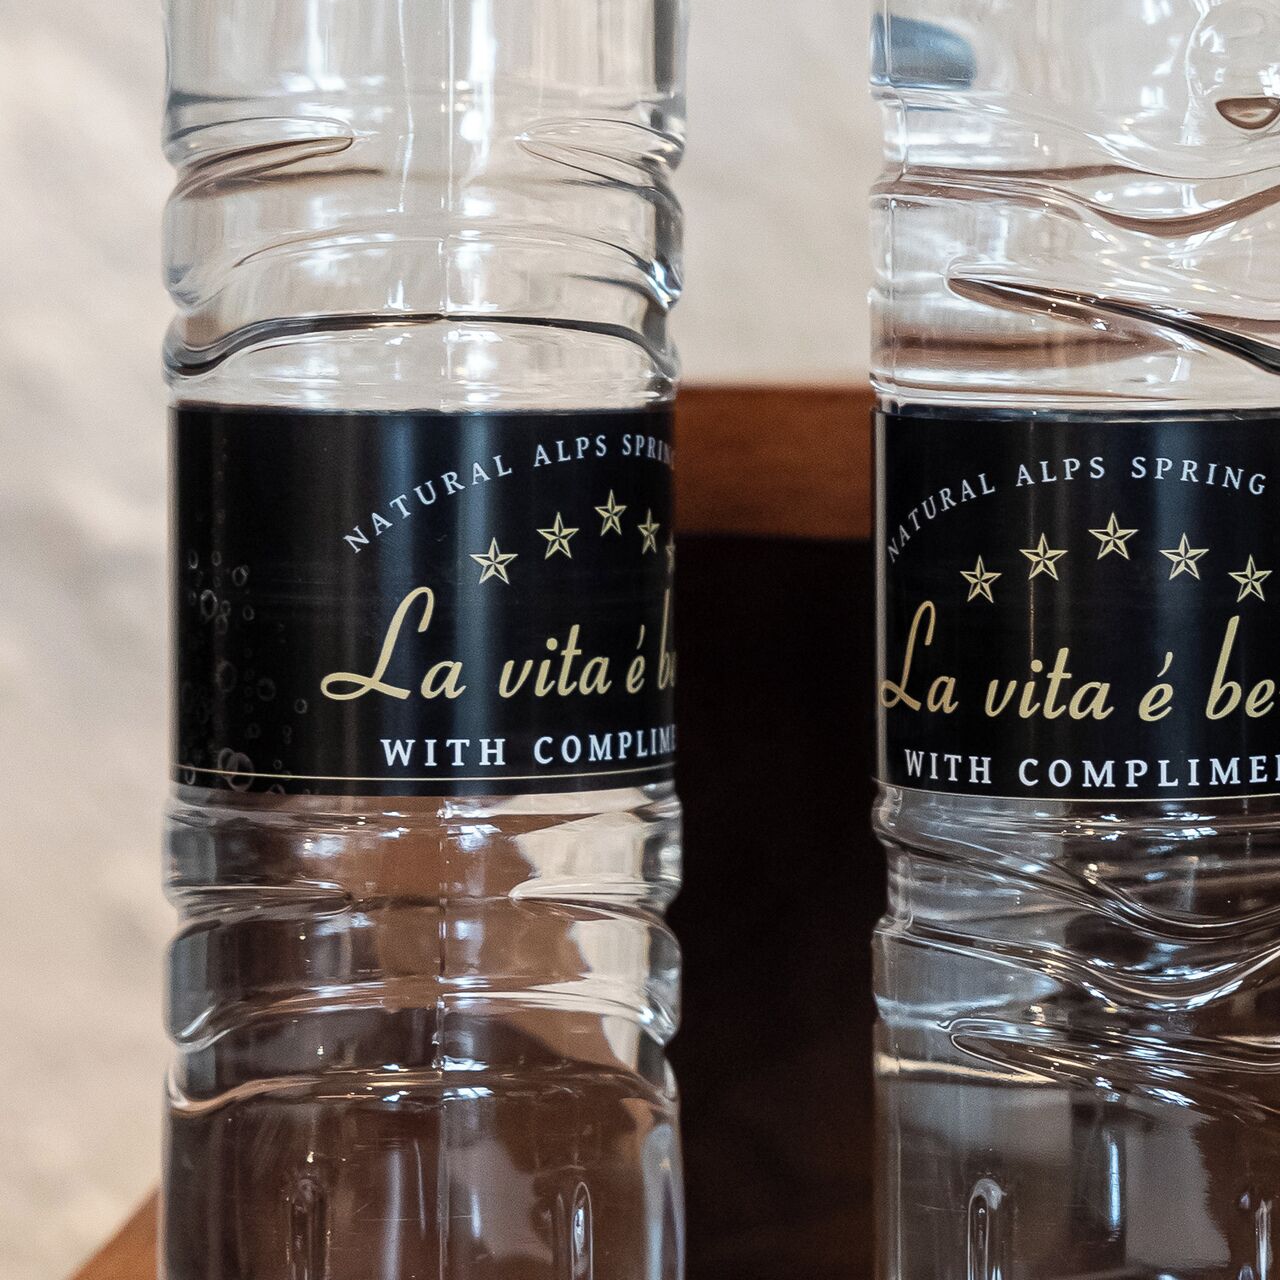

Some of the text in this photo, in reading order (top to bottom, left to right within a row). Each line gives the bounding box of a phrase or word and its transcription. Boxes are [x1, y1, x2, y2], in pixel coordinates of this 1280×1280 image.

[343, 454, 513, 554] NATURAL
[533, 434, 607, 467] ALPS
[887, 472, 996, 563] NATURAL
[1015, 456, 1105, 487] ALPS
[1131, 456, 1267, 495] SPRING
[320, 586, 467, 701] La
[498, 624, 612, 699] vita
[625, 624, 646, 694] é
[879, 600, 959, 715] La
[984, 647, 1115, 720] vita
[1138, 651, 1174, 722] é
[379, 738, 506, 767] WITH
[904, 748, 992, 784] WITH
